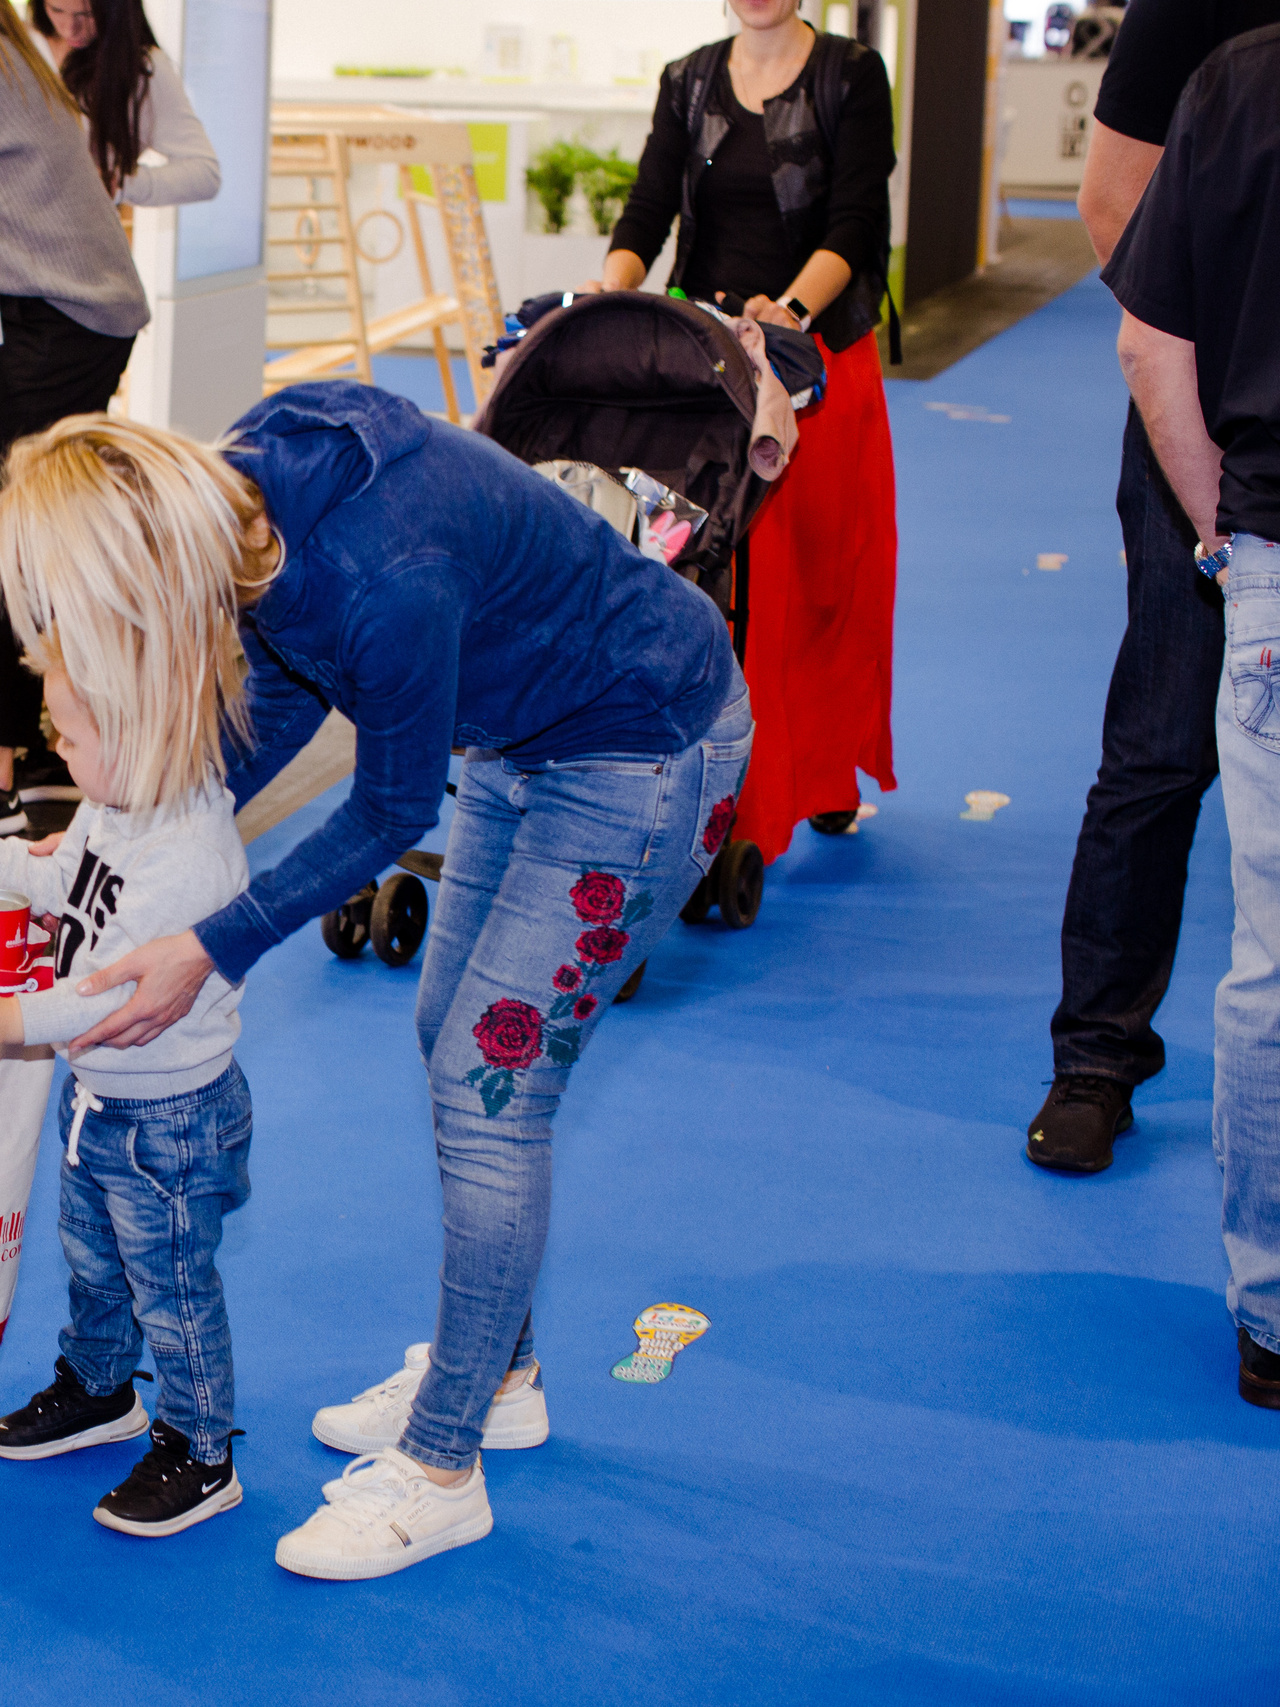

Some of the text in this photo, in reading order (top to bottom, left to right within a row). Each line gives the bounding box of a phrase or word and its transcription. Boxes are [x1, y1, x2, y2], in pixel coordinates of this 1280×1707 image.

[654, 1330, 681, 1342] WE
[638, 1337, 685, 1353] BUILD
[637, 1347, 676, 1359] FUN!
[407, 1500, 431, 1521] REPLAY
